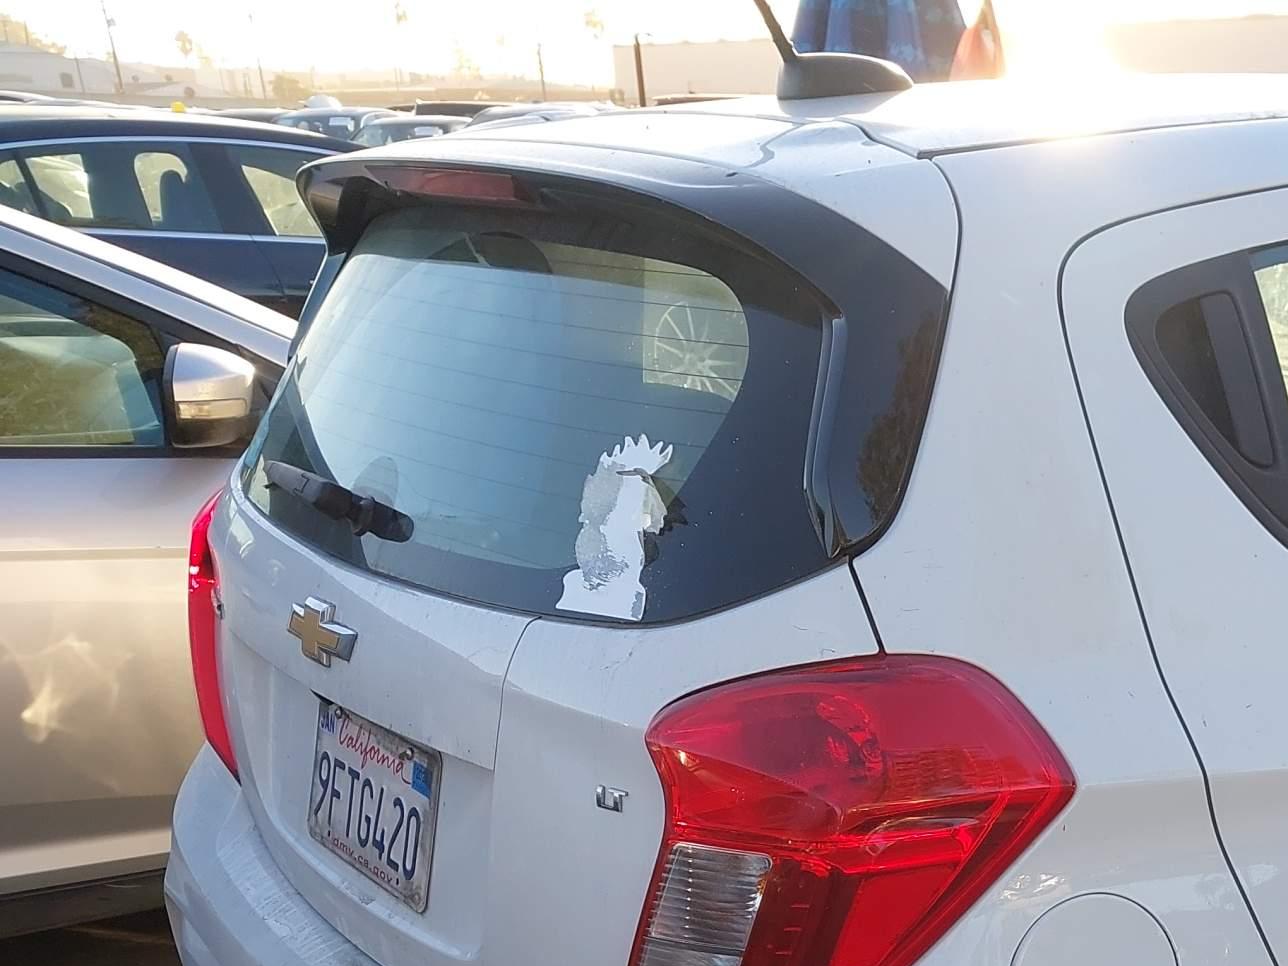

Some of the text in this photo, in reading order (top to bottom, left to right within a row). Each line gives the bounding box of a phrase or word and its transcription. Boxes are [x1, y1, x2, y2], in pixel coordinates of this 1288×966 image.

[320, 712, 335, 734] JAN
[339, 717, 411, 785] California
[313, 750, 421, 882] 9FTG420
[596, 784, 629, 813] LT
[332, 833, 393, 883] dmv.ca.gov
